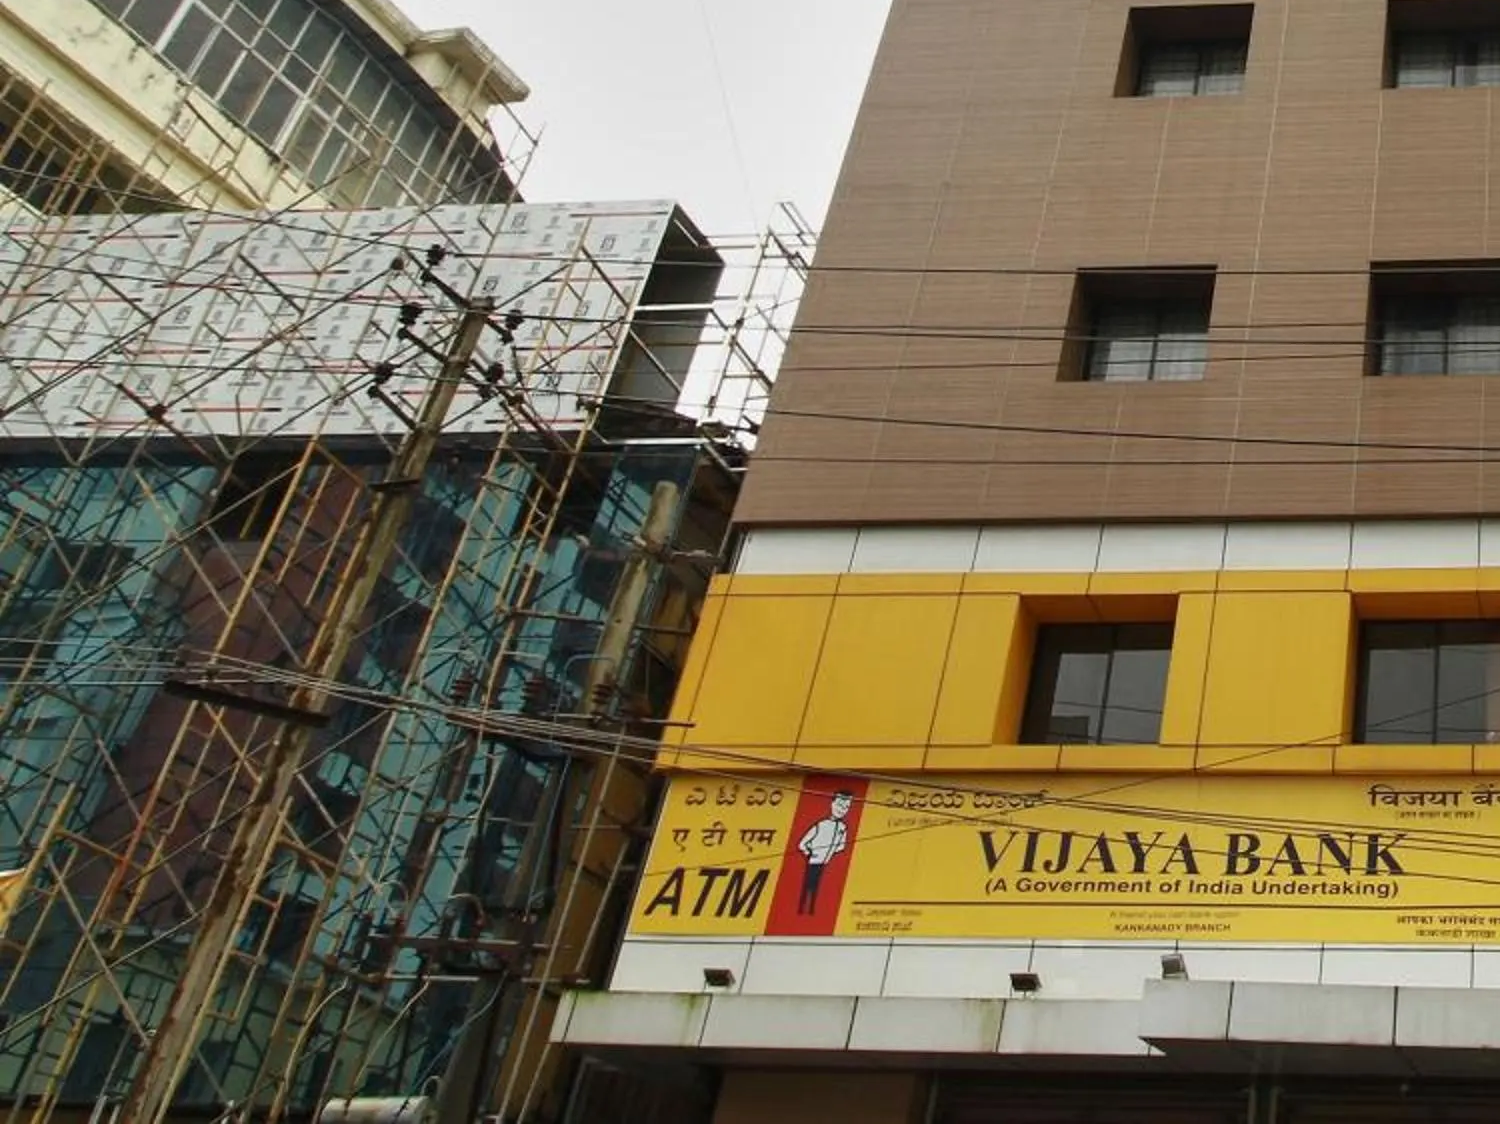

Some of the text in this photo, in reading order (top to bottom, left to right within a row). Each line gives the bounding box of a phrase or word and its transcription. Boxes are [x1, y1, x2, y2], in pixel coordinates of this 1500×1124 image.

[1367, 783, 1463, 807] विजया
[672, 820, 777, 853] ए टी एम
[978, 829, 1408, 877] VIJAYA BANK
[643, 866, 771, 919] ATM
[985, 877, 1400, 899] (A Government of India Undertaking)
[1185, 923, 1231, 933] BRANCH
